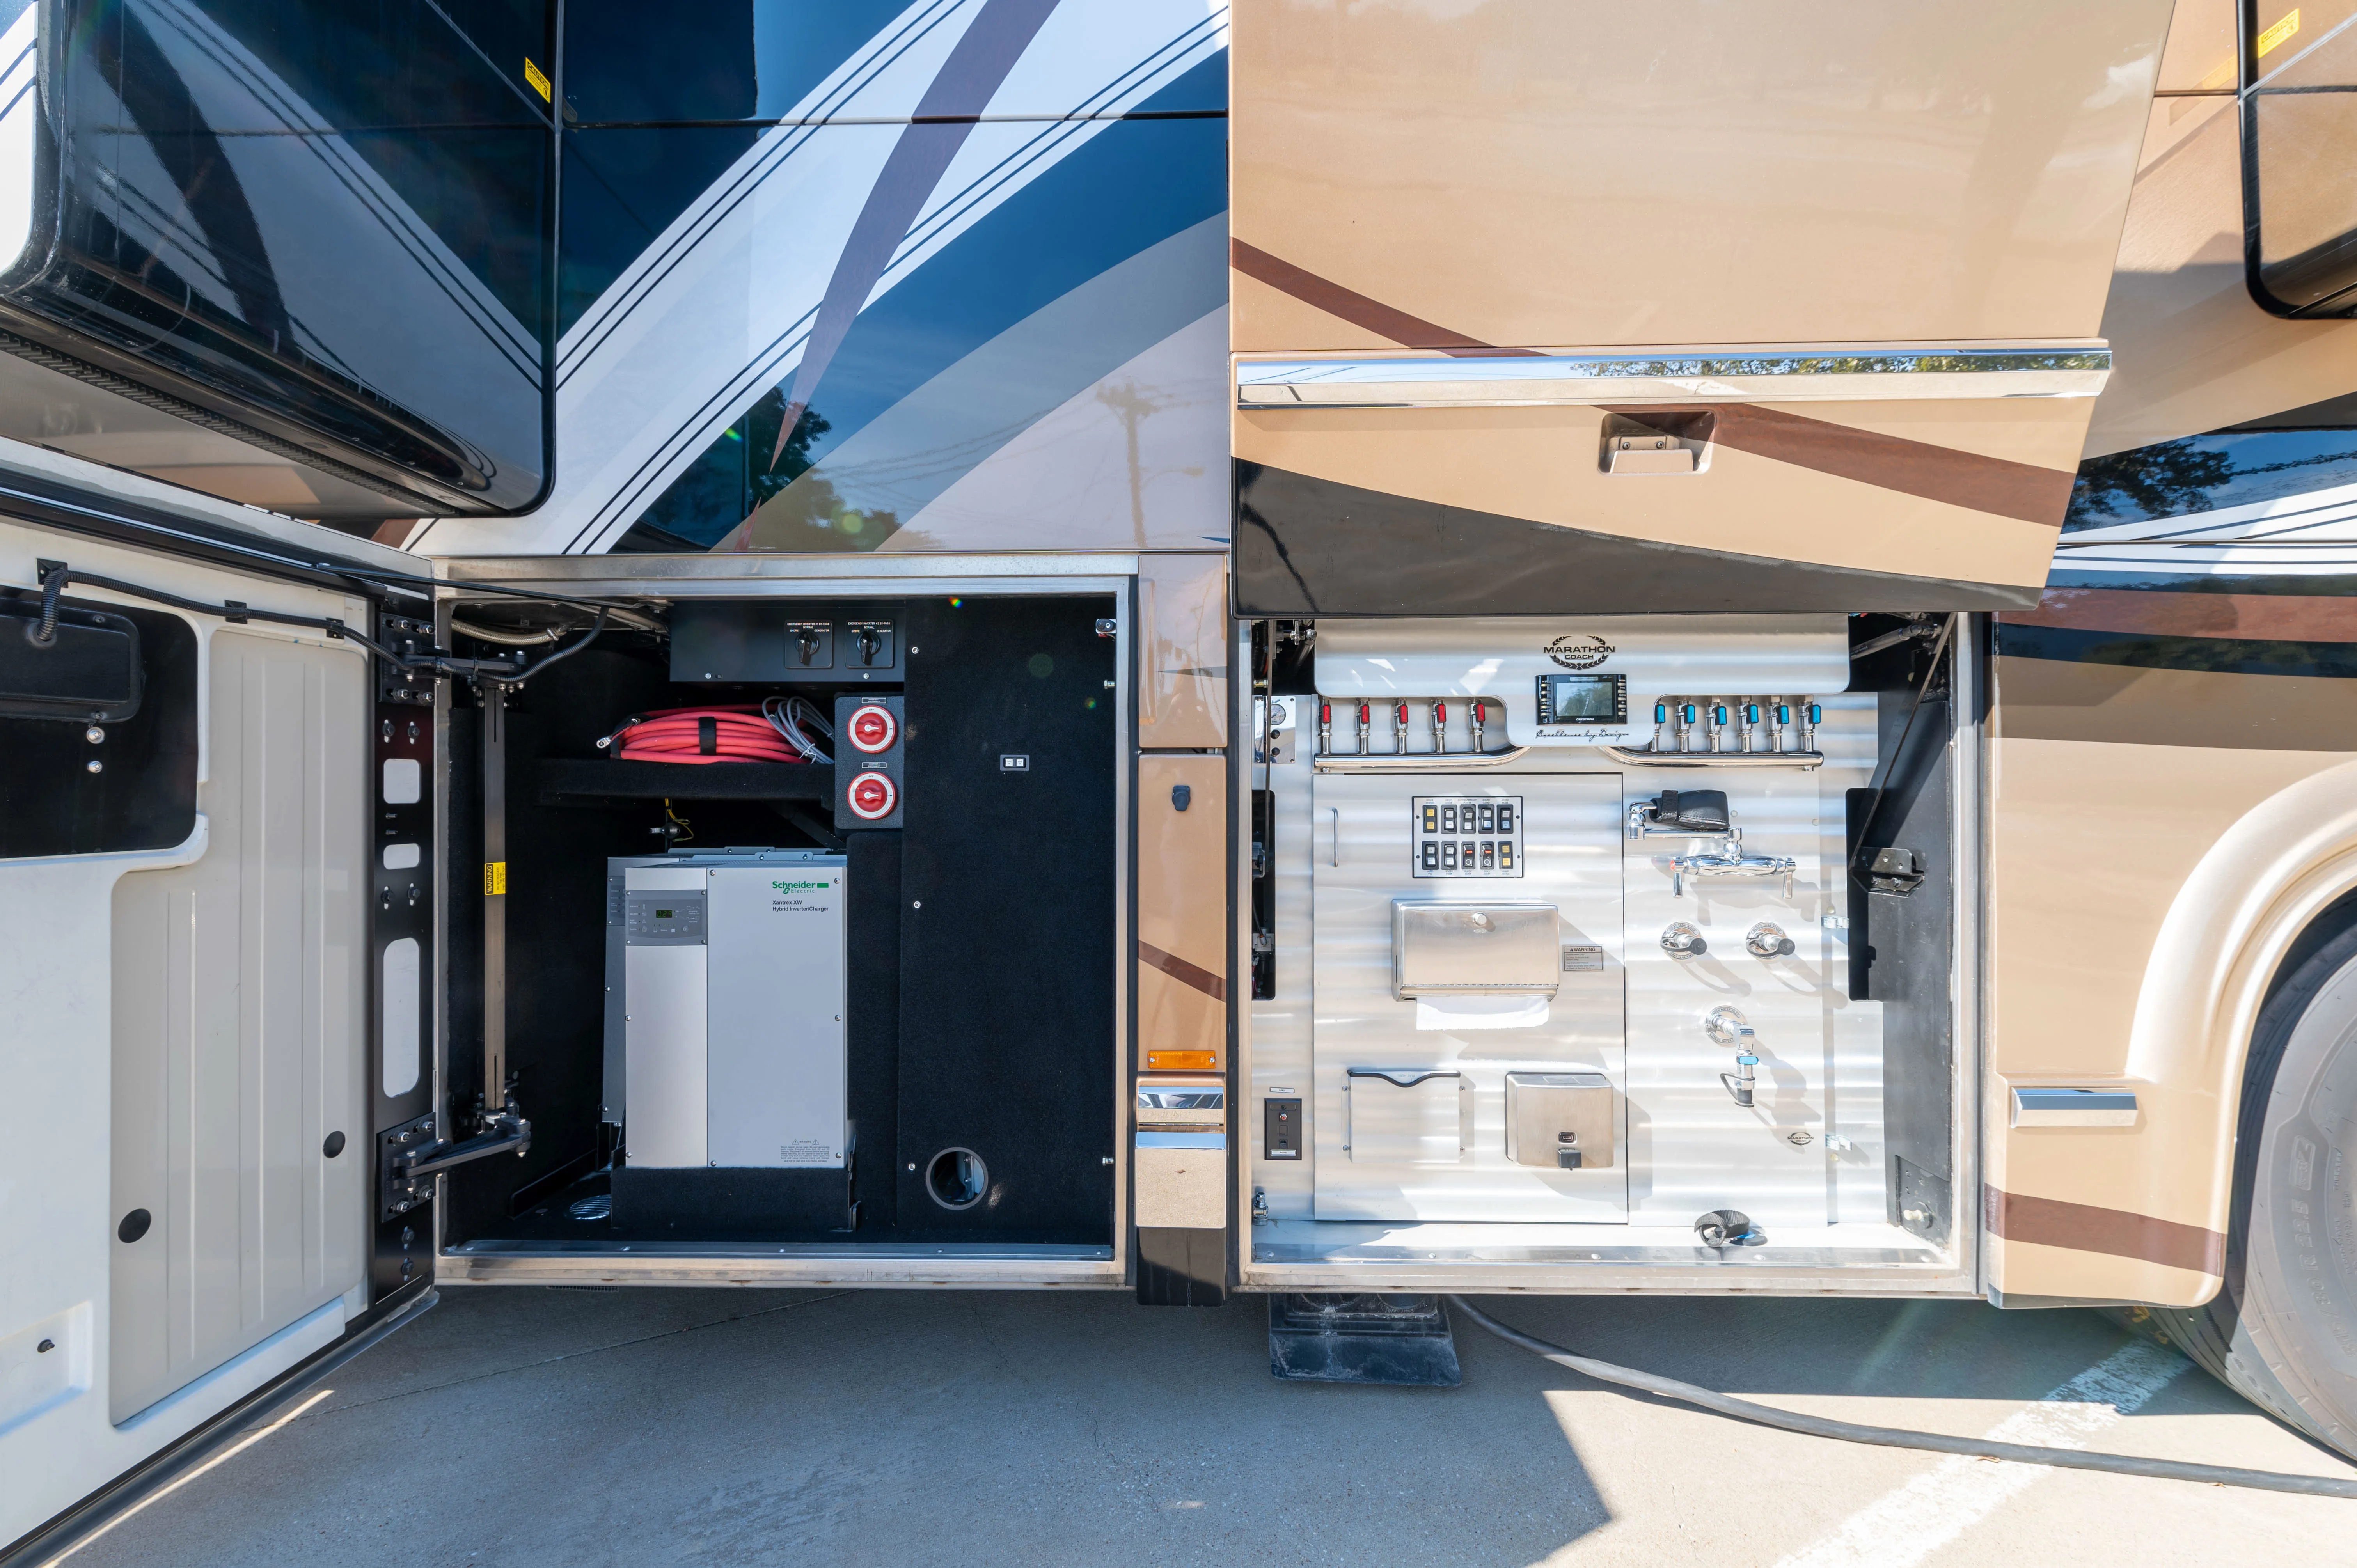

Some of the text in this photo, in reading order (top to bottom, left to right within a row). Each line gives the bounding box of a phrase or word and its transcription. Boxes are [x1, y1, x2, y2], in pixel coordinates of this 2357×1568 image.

[528, 63, 549, 89] CAUTION
[1535, 729, 1629, 742] Excellence by Design
[2291, 1197, 2313, 1248] 22.5
[2298, 1254, 2319, 1271] R
